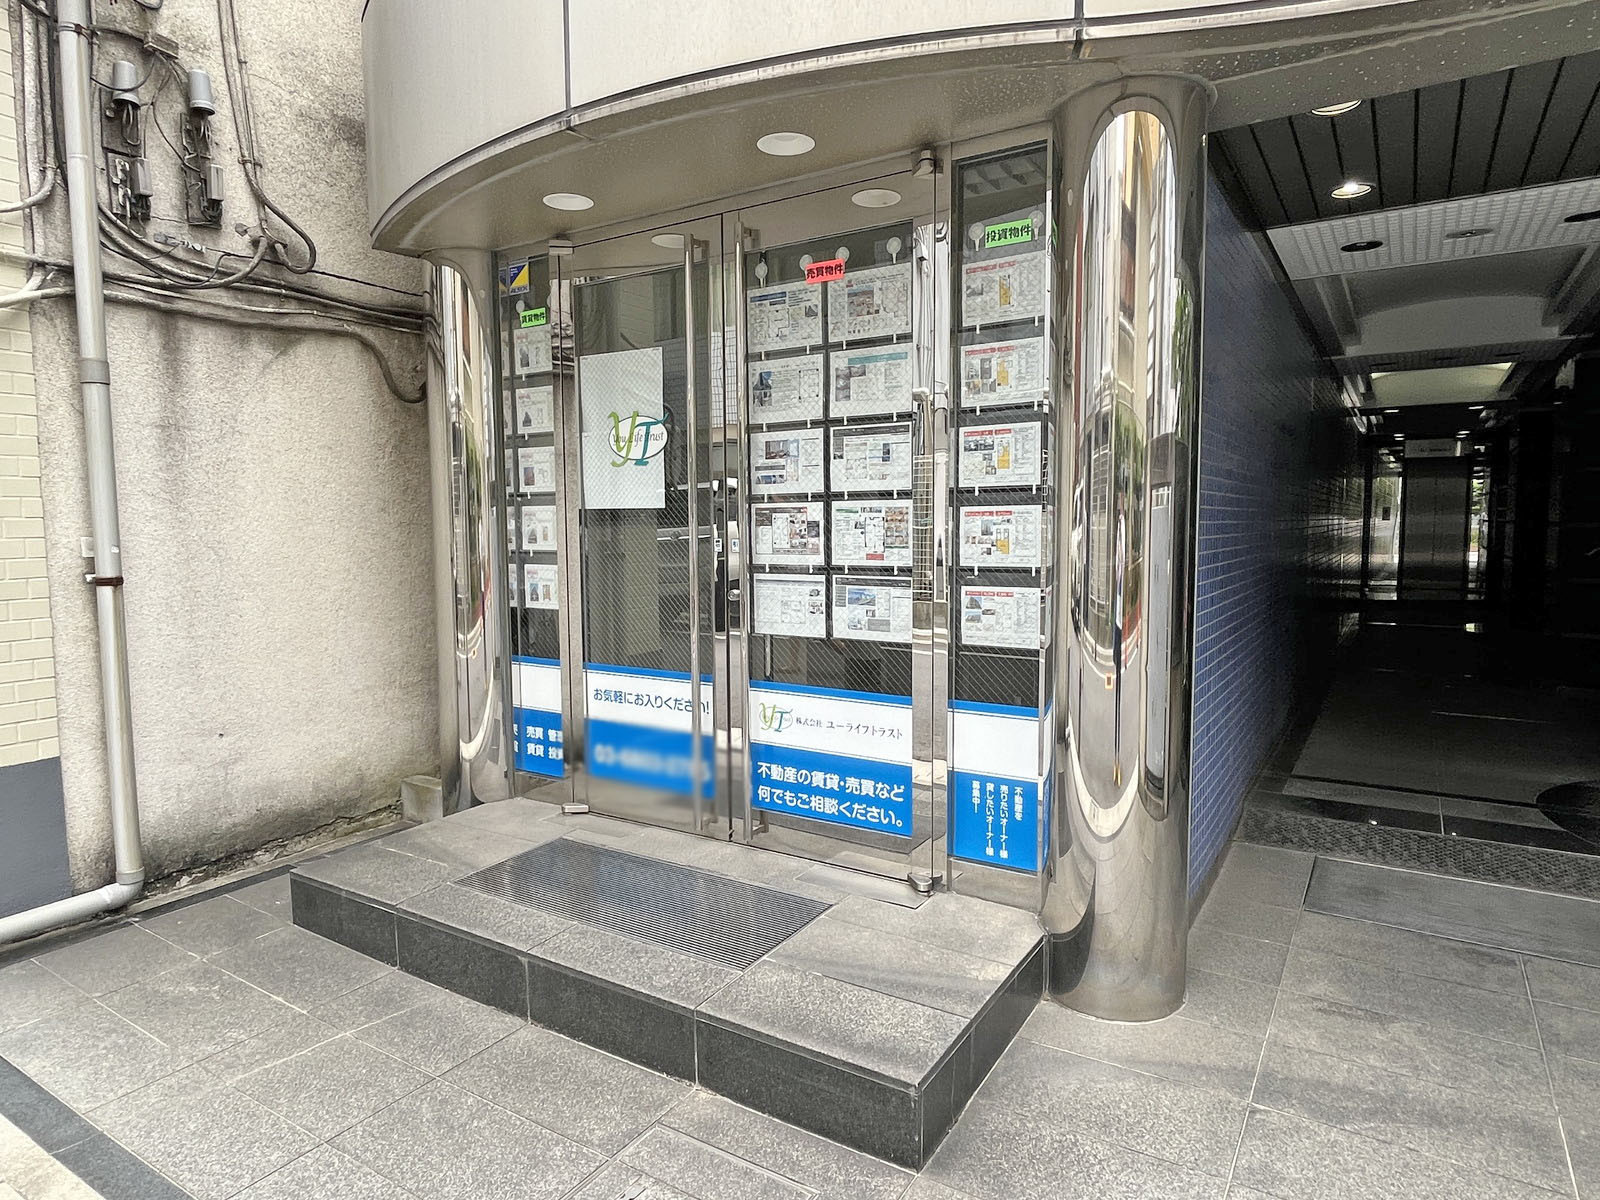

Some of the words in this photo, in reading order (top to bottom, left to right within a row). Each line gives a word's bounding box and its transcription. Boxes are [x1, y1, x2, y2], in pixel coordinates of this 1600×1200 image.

[986, 223, 1031, 243] 投資物件
[806, 263, 844, 279] 売買物件
[526, 725, 544, 740] 売買
[795, 716, 823, 729] 株式会社
[826, 720, 903, 740] ユーライフトラスト
[757, 761, 905, 803] 不動産の賃貸・売買など
[757, 785, 904, 828] 何でもご相談ください。
